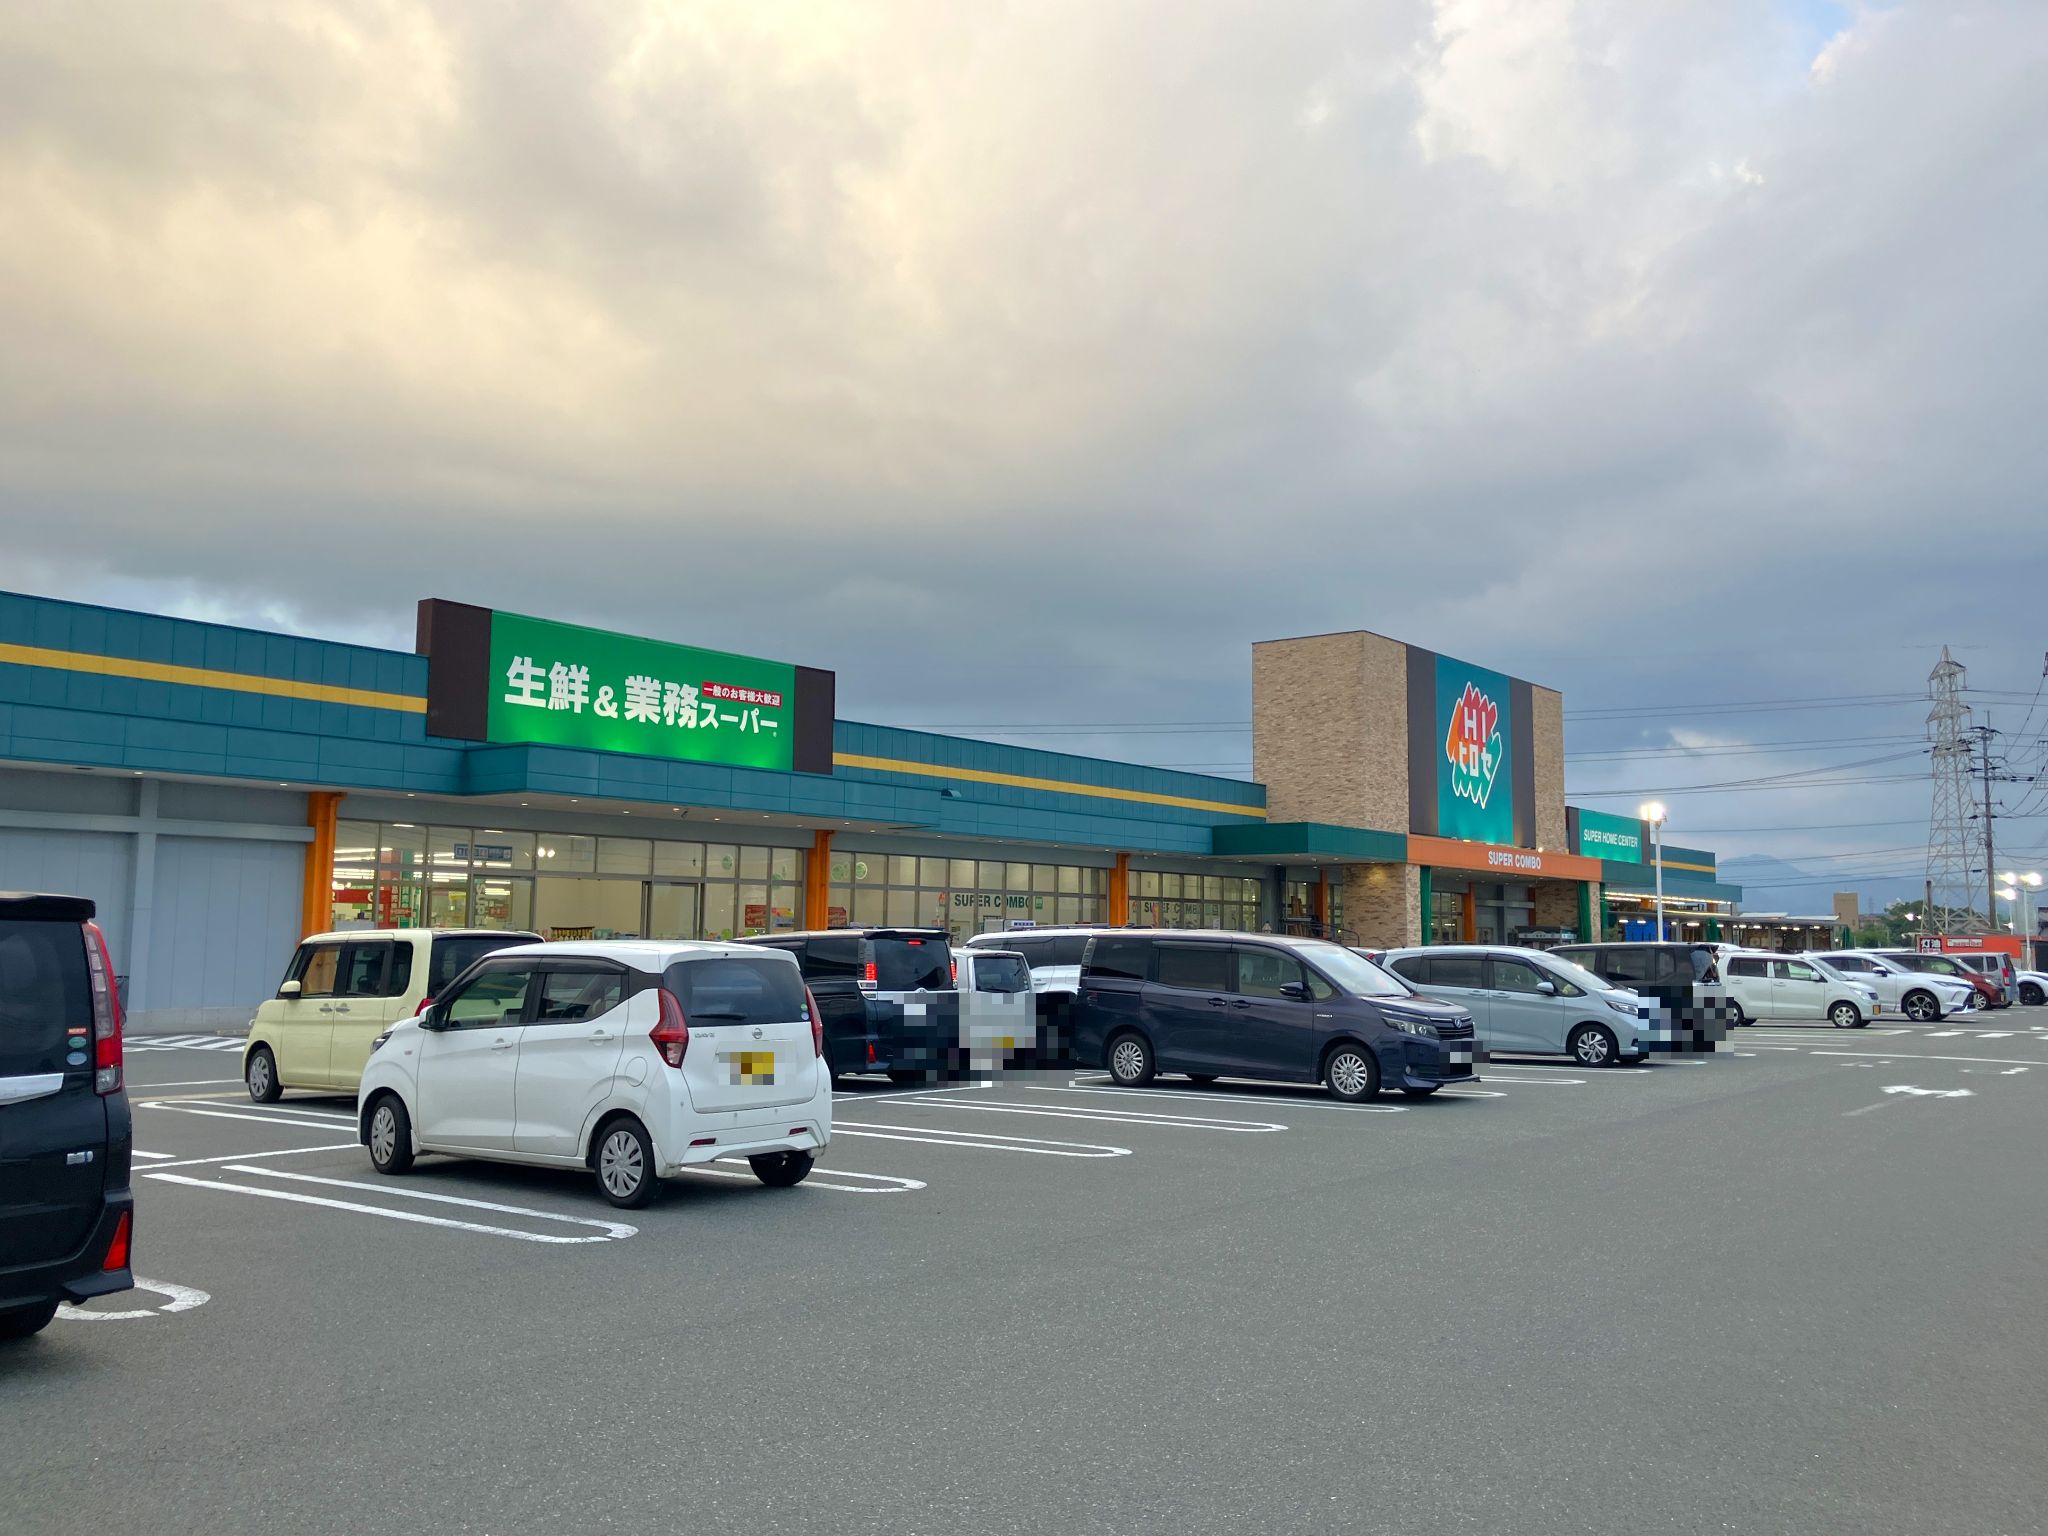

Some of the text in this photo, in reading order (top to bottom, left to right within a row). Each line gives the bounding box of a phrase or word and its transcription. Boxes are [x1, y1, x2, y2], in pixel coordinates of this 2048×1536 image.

[703, 685, 780, 706] 一般のお客様大歓迎
[1464, 706, 1486, 743] HI
[1583, 829, 1638, 848] SUPER HOME CENTER
[1488, 850, 1541, 870] SUPER COMBO
[994, 895, 1030, 910] CMB
